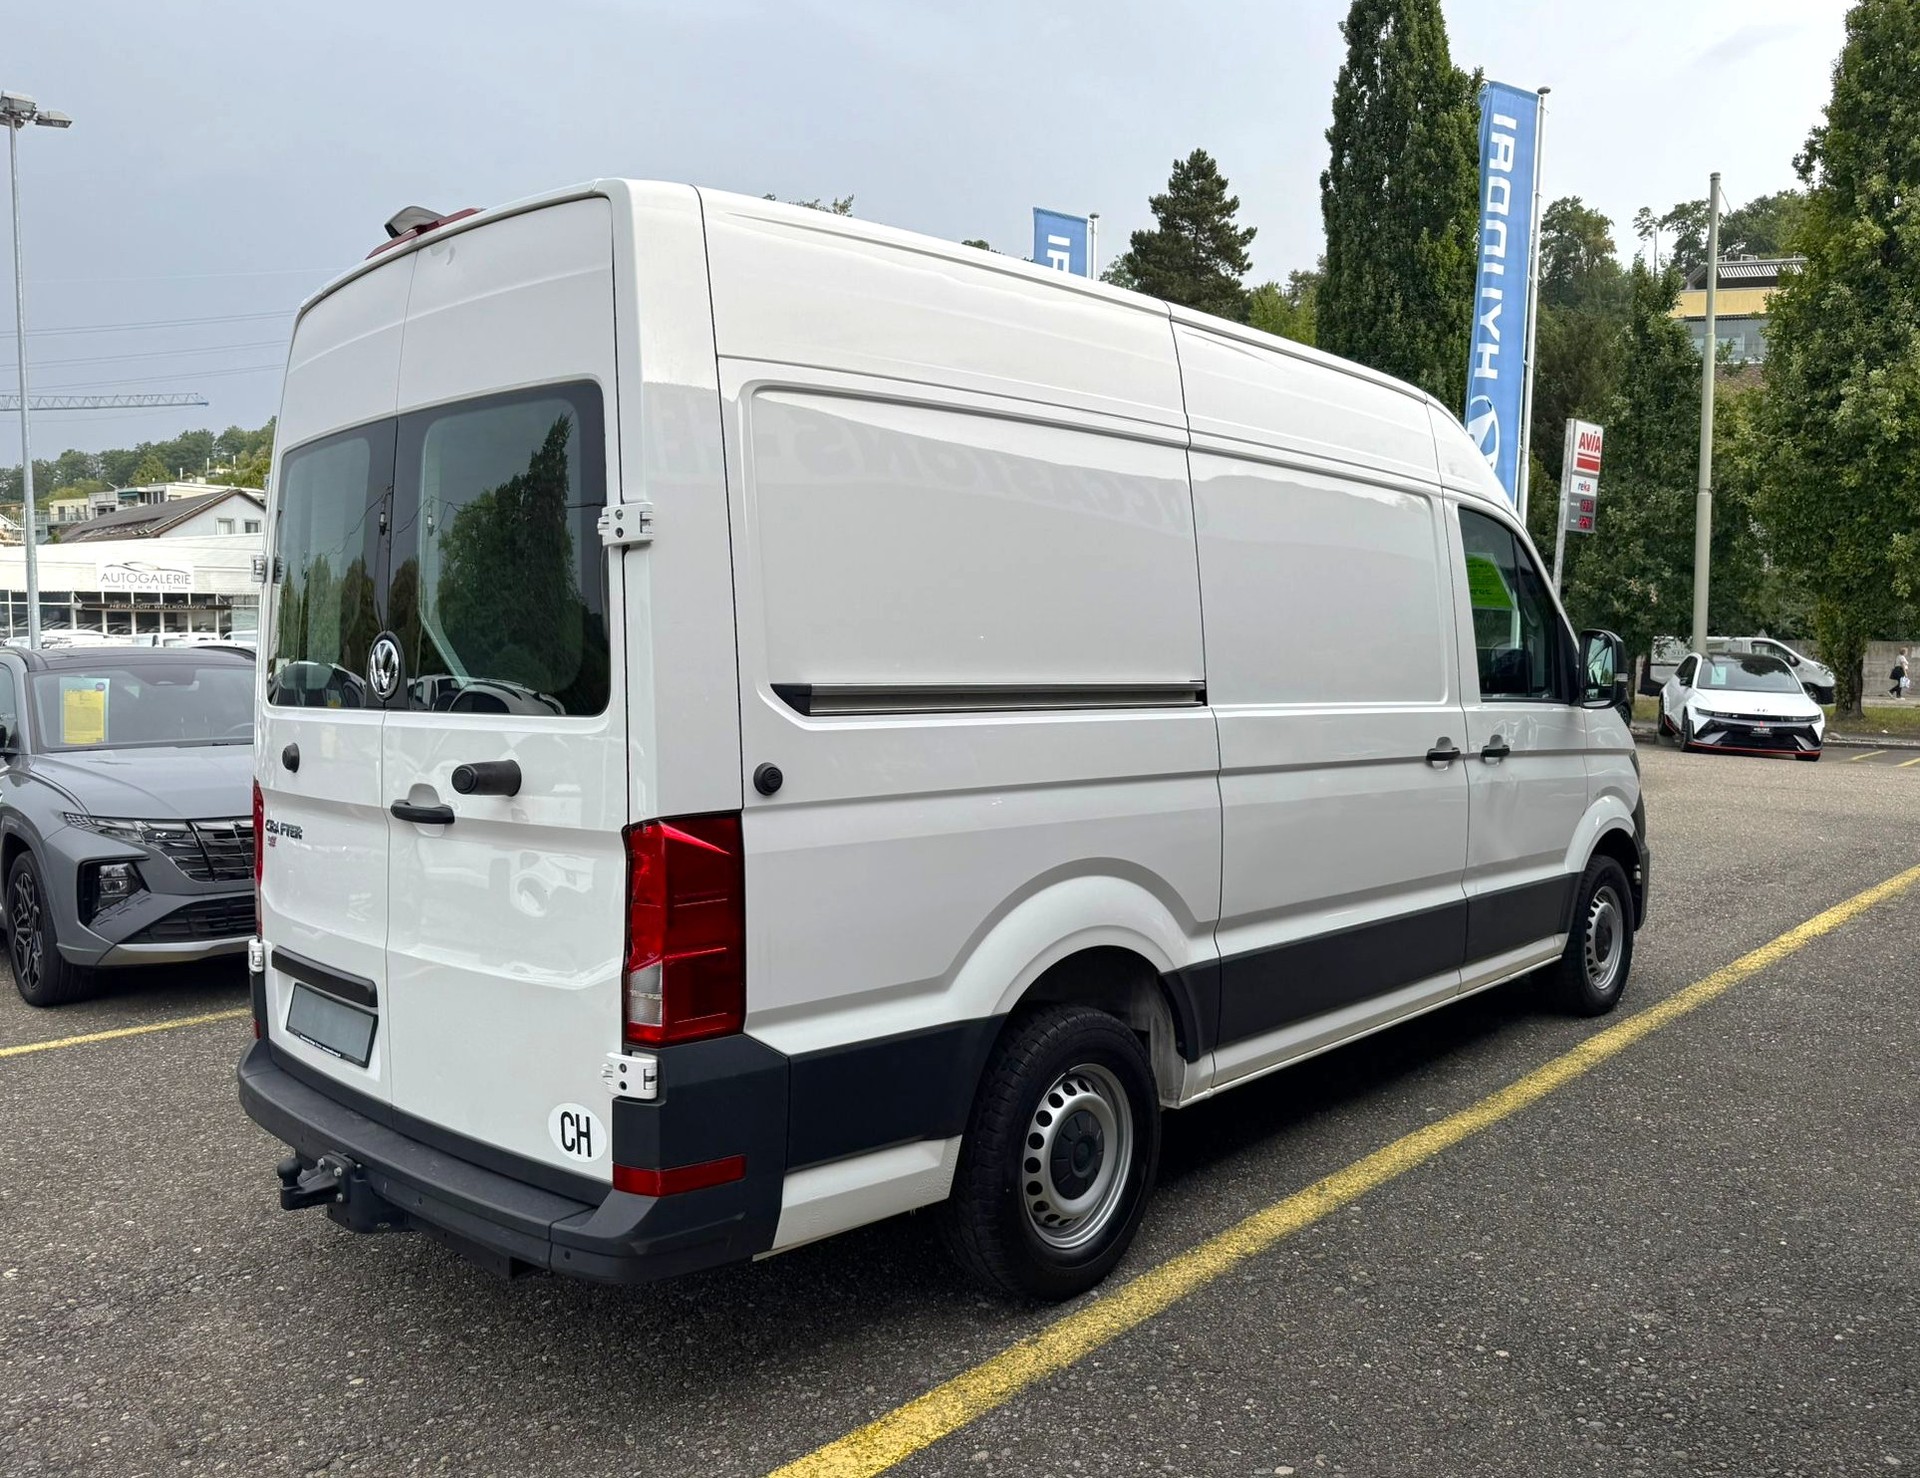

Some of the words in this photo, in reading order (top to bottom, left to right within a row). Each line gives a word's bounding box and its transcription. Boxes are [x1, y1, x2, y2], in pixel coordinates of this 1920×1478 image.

[1578, 430, 1601, 453] AVIA
[100, 572, 192, 585] AUTOGALERIE
[265, 819, 303, 840] CRAFTER
[560, 1111, 592, 1158] CH
